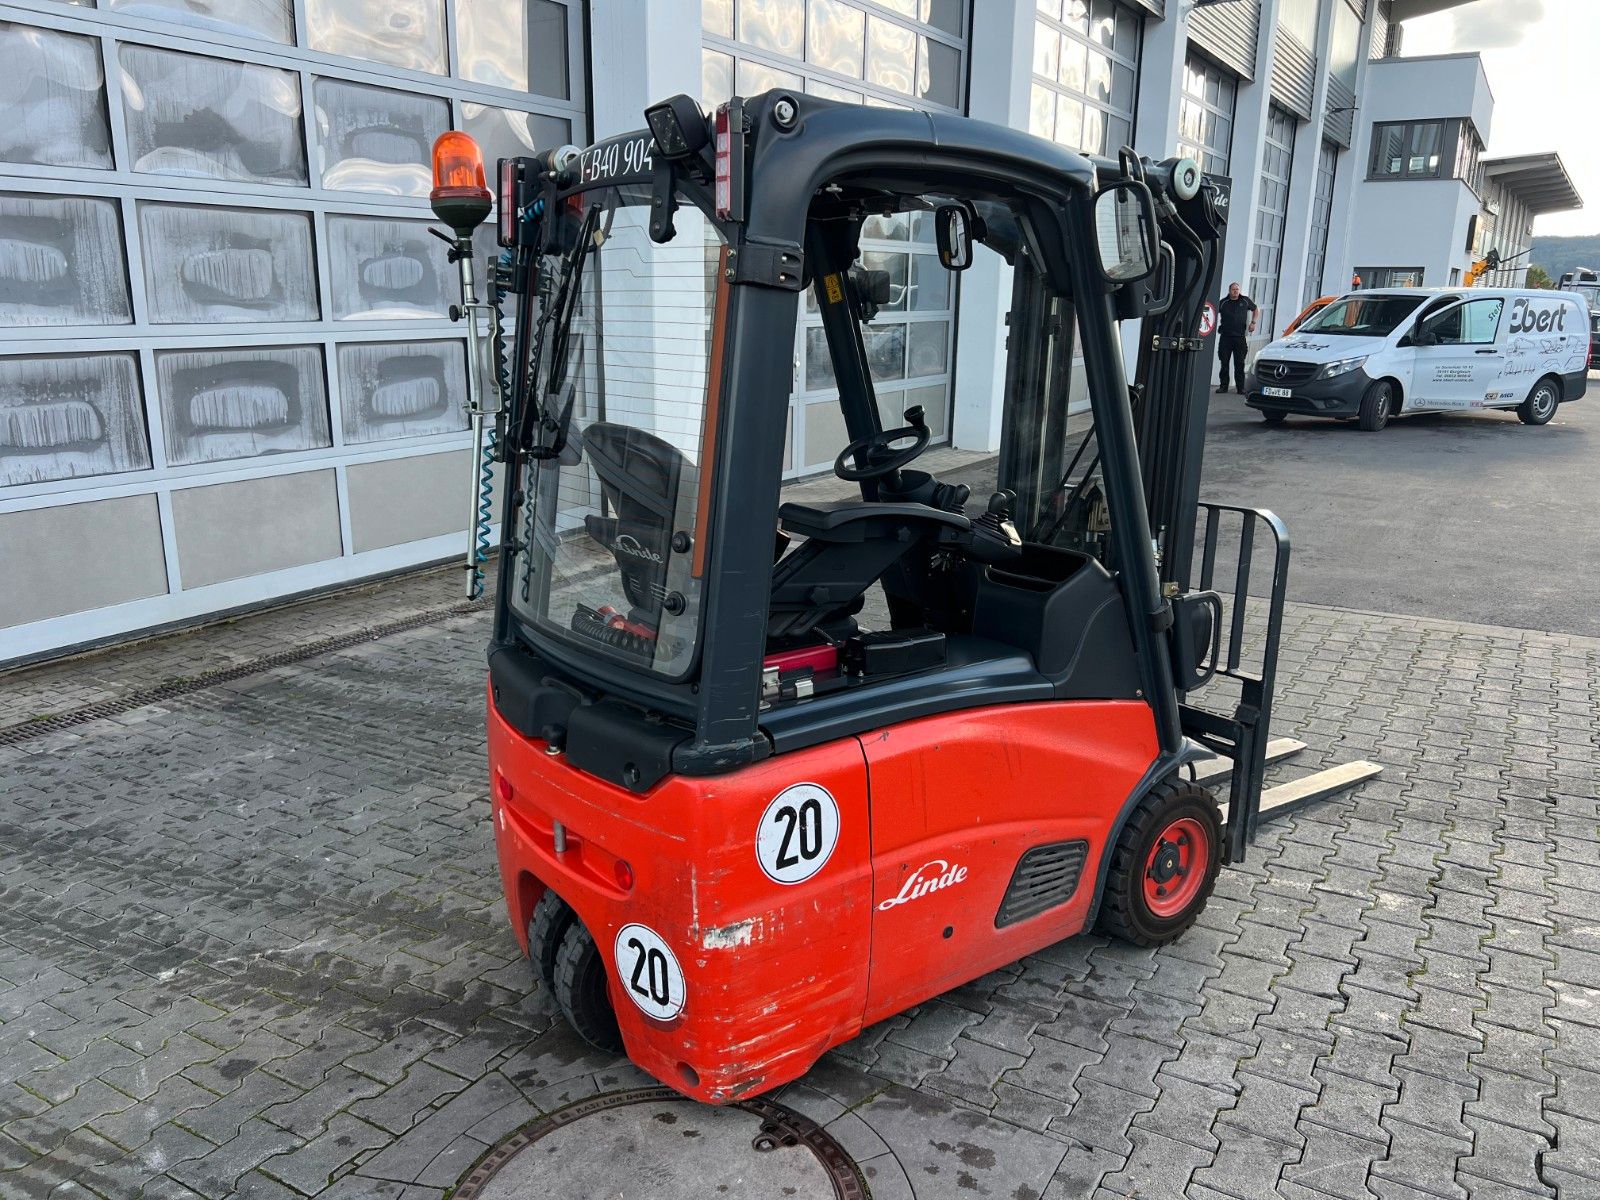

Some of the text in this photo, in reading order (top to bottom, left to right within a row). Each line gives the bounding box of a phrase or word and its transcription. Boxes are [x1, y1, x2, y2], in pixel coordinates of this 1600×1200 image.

[774, 797, 823, 871] 20
[874, 859, 968, 911] Linde
[627, 936, 670, 1007] 20
